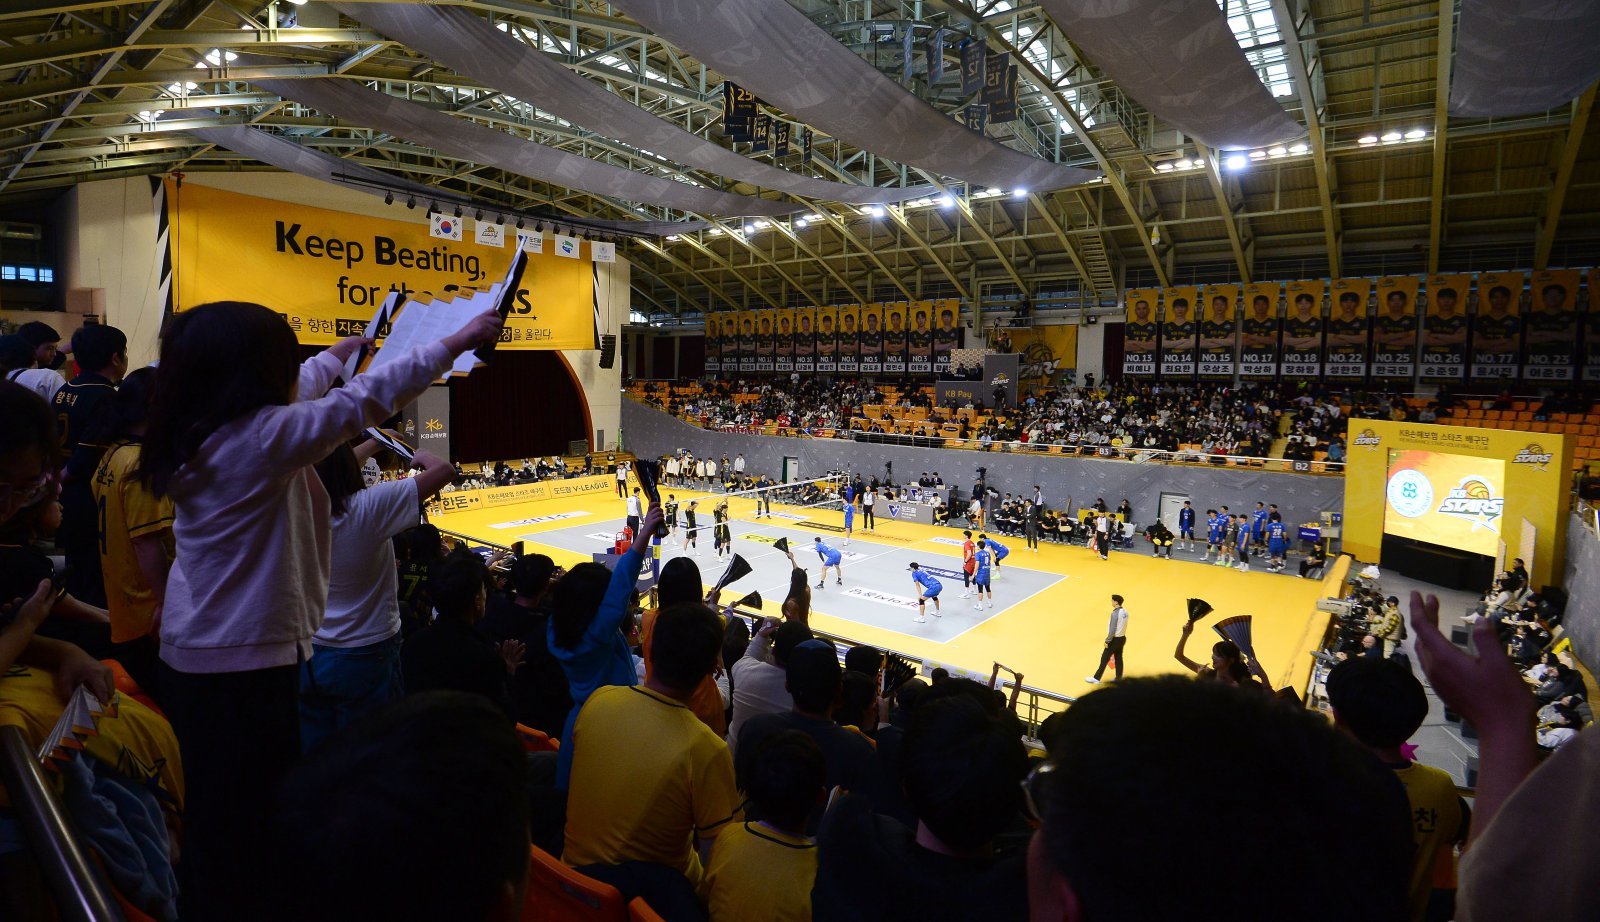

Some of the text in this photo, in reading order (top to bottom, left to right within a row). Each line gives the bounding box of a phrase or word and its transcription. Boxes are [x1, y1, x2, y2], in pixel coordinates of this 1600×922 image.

[275, 220, 486, 282] Keep Beating,
[336, 276, 381, 306] for
[308, 318, 334, 334] 향한
[1165, 365, 1191, 373] 최요한
[1203, 364, 1230, 373] 우상조
[958, 390, 972, 399] Pay
[1400, 430, 1489, 446] KB손해보험 스타즈 배구단
[1295, 462, 1308, 471] B2
[1440, 498, 1504, 513] STARS
[1414, 807, 1438, 832] 찬
